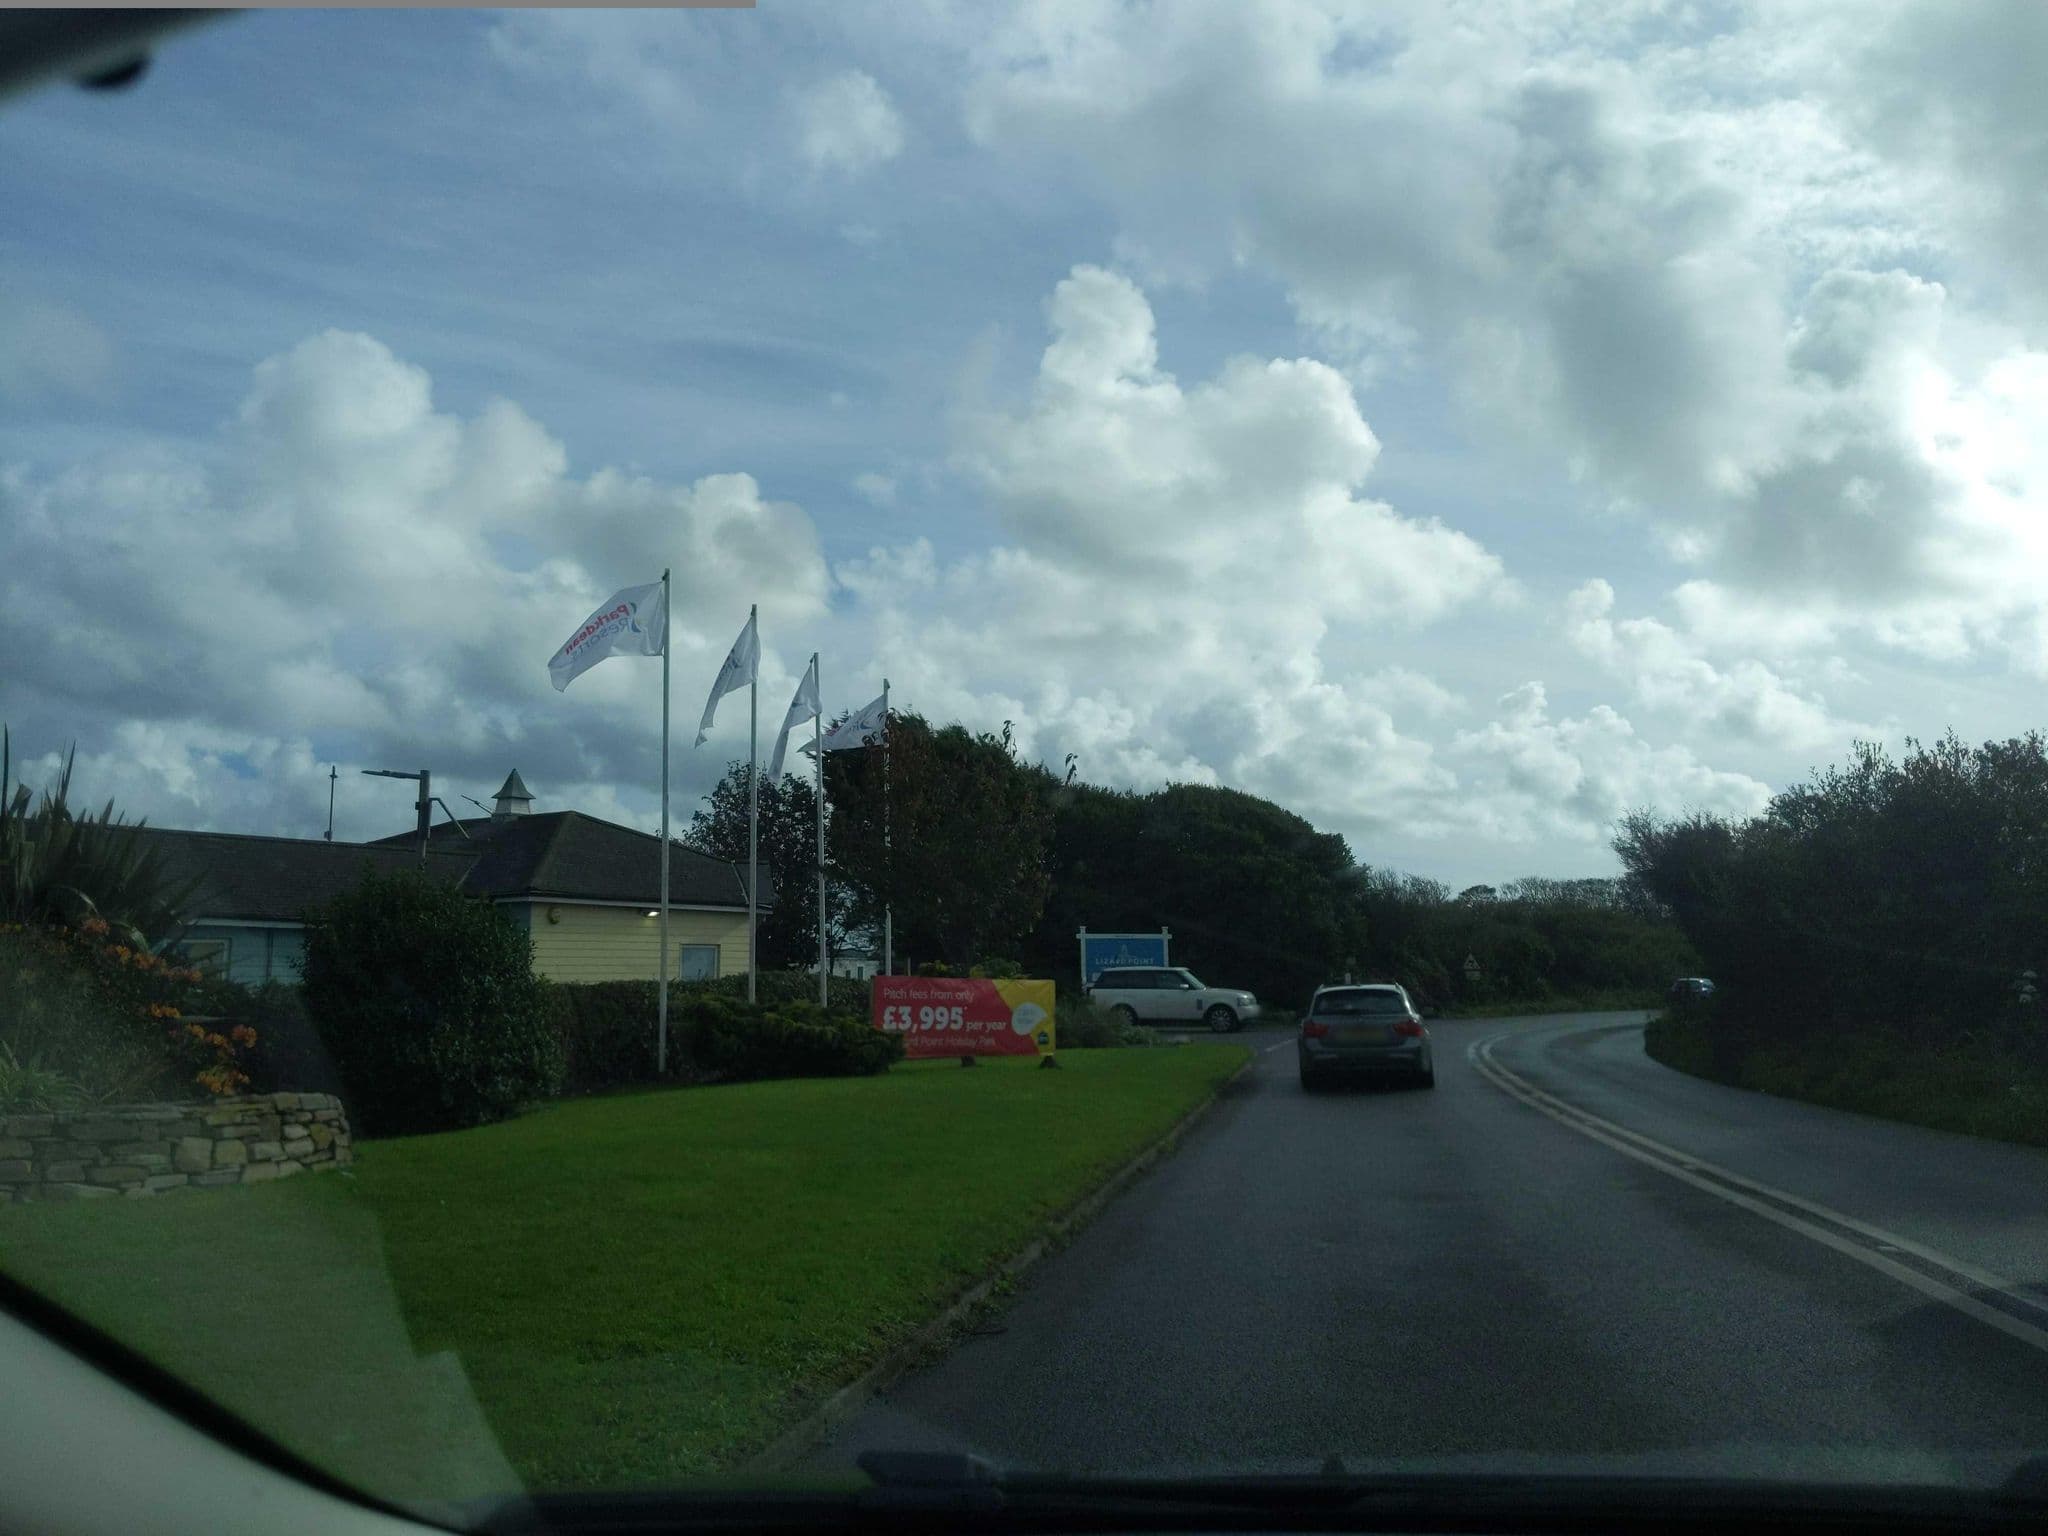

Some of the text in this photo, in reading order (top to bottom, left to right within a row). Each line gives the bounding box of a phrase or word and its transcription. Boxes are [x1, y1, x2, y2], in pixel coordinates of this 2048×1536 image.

[883, 987, 974, 1002] Pitch fees from only
[966, 1022, 984, 1033] per
[987, 1021, 1006, 1033] year
